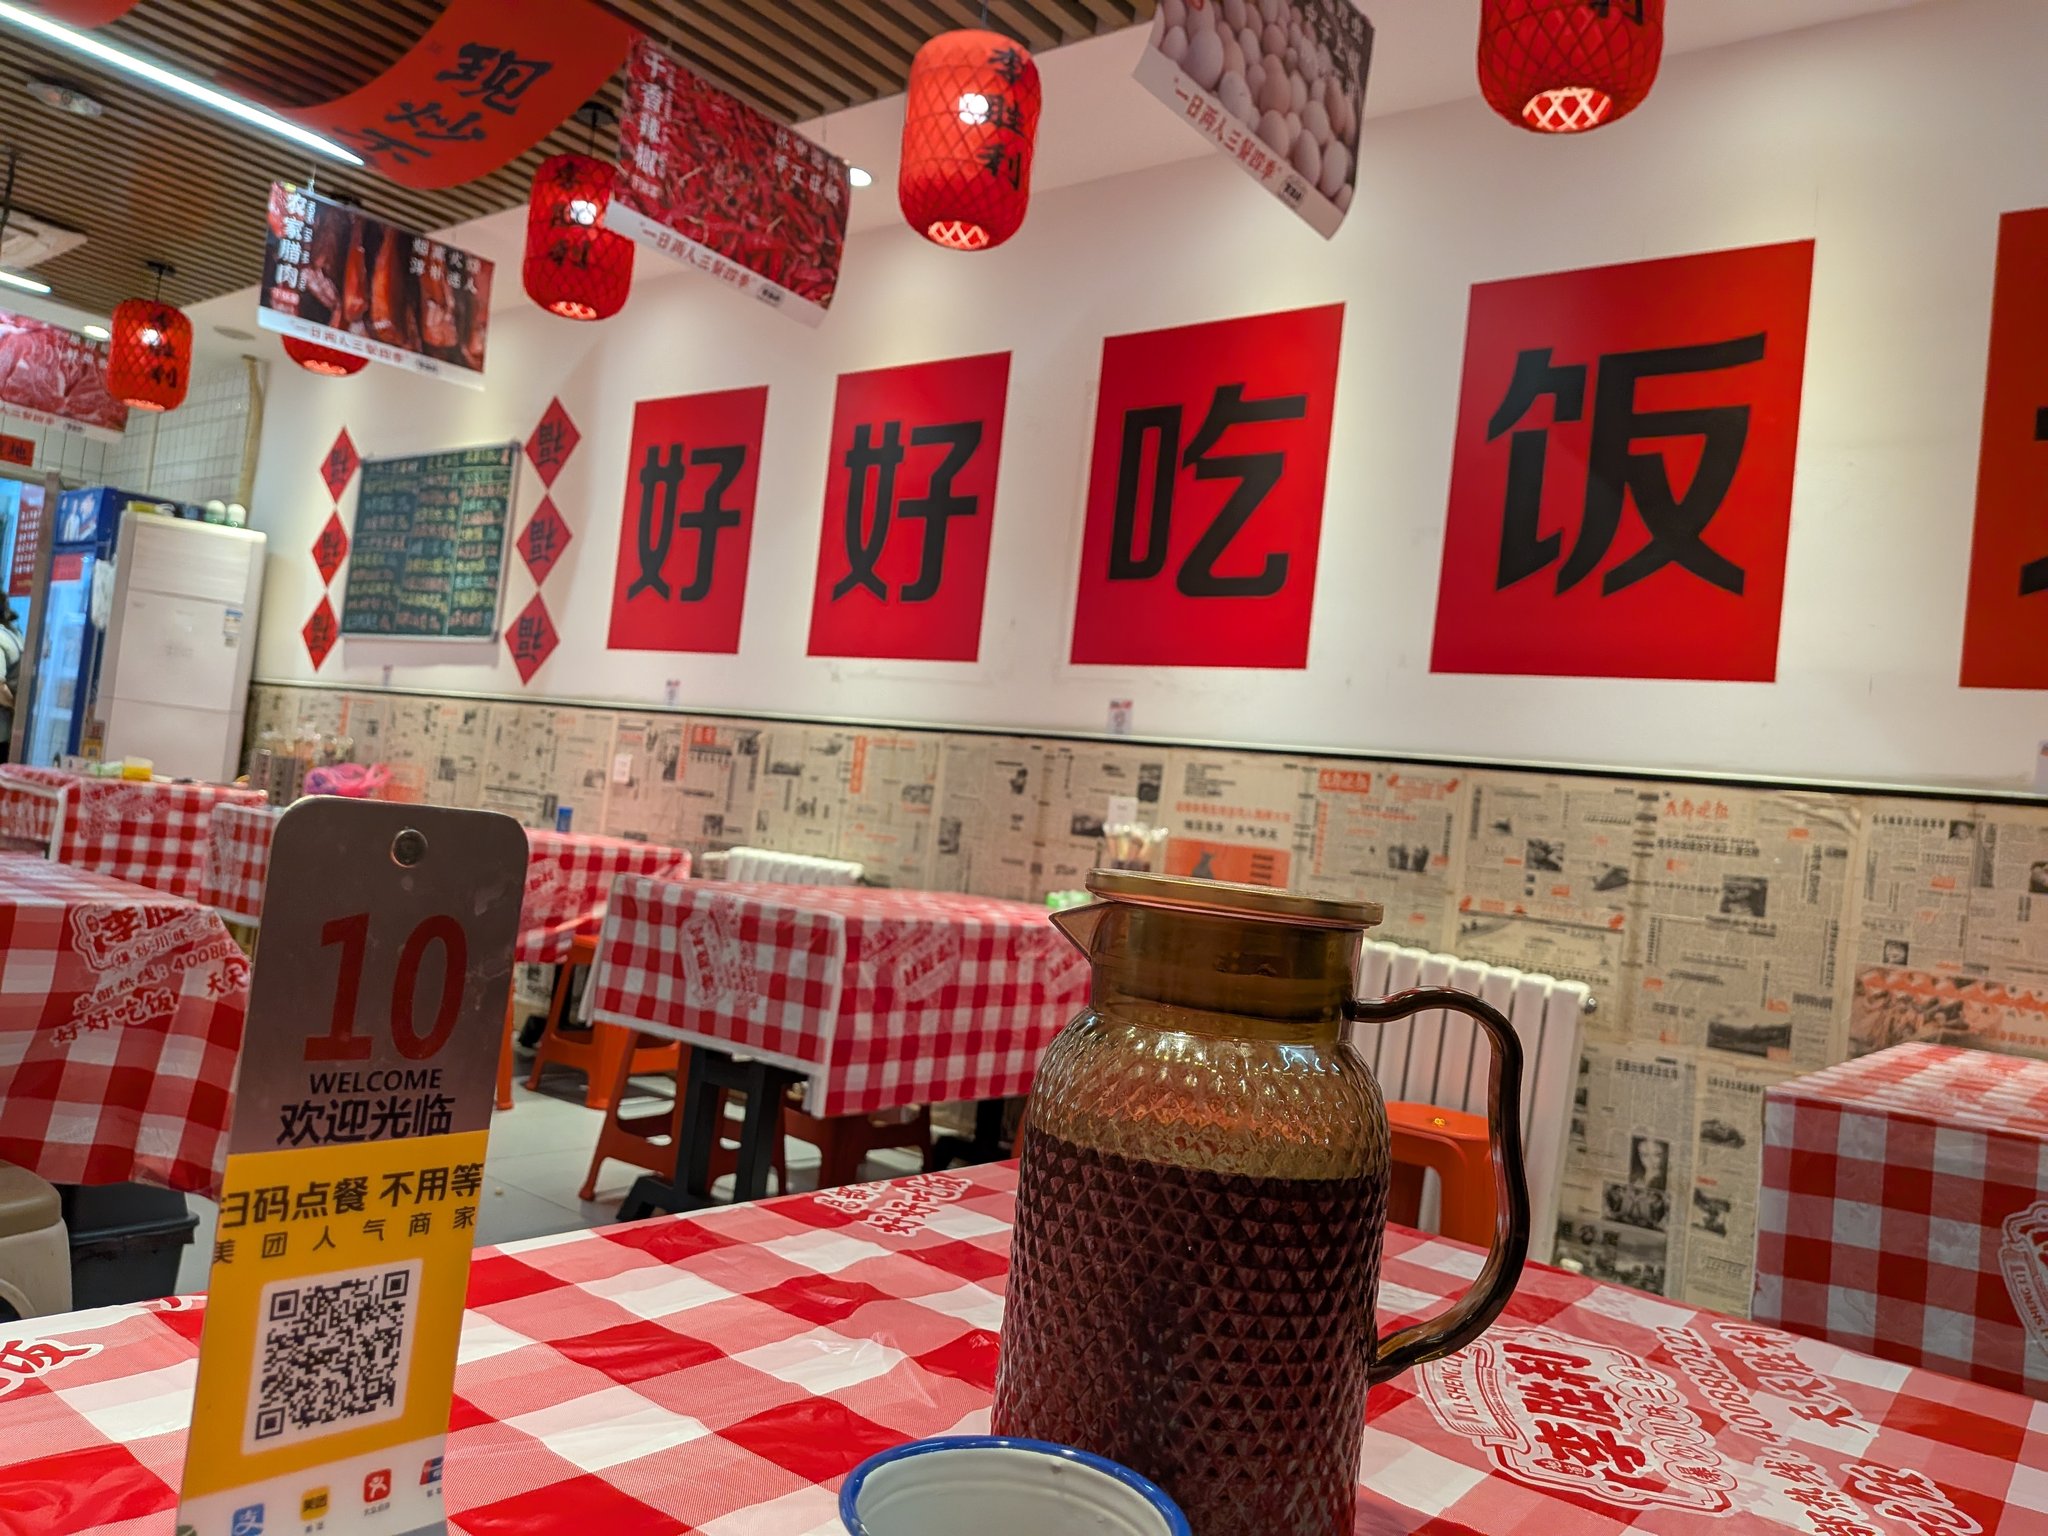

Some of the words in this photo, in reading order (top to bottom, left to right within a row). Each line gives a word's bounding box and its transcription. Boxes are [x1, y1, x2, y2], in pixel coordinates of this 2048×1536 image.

[627, 443, 746, 603] 好
[832, 421, 983, 603] 好
[1106, 382, 1308, 598] 吃
[1486, 331, 1767, 598] 饭
[304, 912, 468, 1062] 10
[310, 1069, 443, 1094] WELCOME
[276, 1094, 456, 1147] 欢迎光临
[220, 1176, 369, 1229] 扫码点餐
[379, 1162, 484, 1208] 不用等
[213, 1206, 476, 1264] 美团人气商家
[1441, 1366, 1470, 1401] SHENG
[1454, 1402, 1478, 1415] LI
[1502, 1342, 1647, 1475] 李胜利
